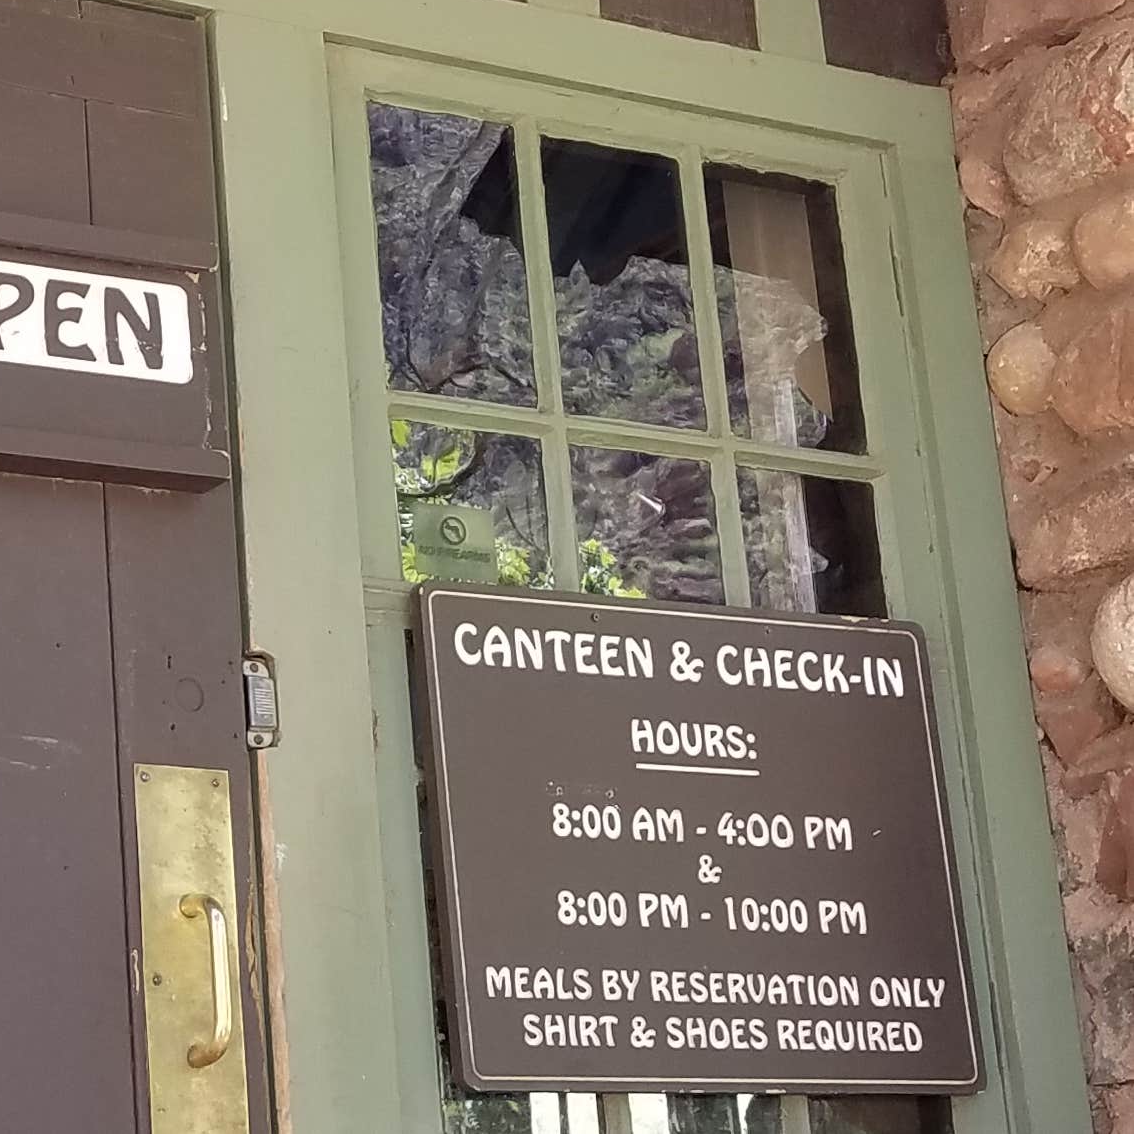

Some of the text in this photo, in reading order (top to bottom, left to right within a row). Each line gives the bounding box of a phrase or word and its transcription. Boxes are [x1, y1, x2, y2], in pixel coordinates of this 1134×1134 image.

[454, 622, 904, 698] CANTEEN & CHECK-IN
[631, 718, 758, 760] HOURS:
[552, 802, 853, 851] 8:00 AM - 4:00 PM
[697, 854, 723, 884] &
[557, 890, 867, 935] 8:00 PM - 10:00 PM
[485, 966, 945, 1008] MEALS BY RESERVATION ONLY
[523, 1013, 923, 1052] SHIRT & SHOES REQUIRED
